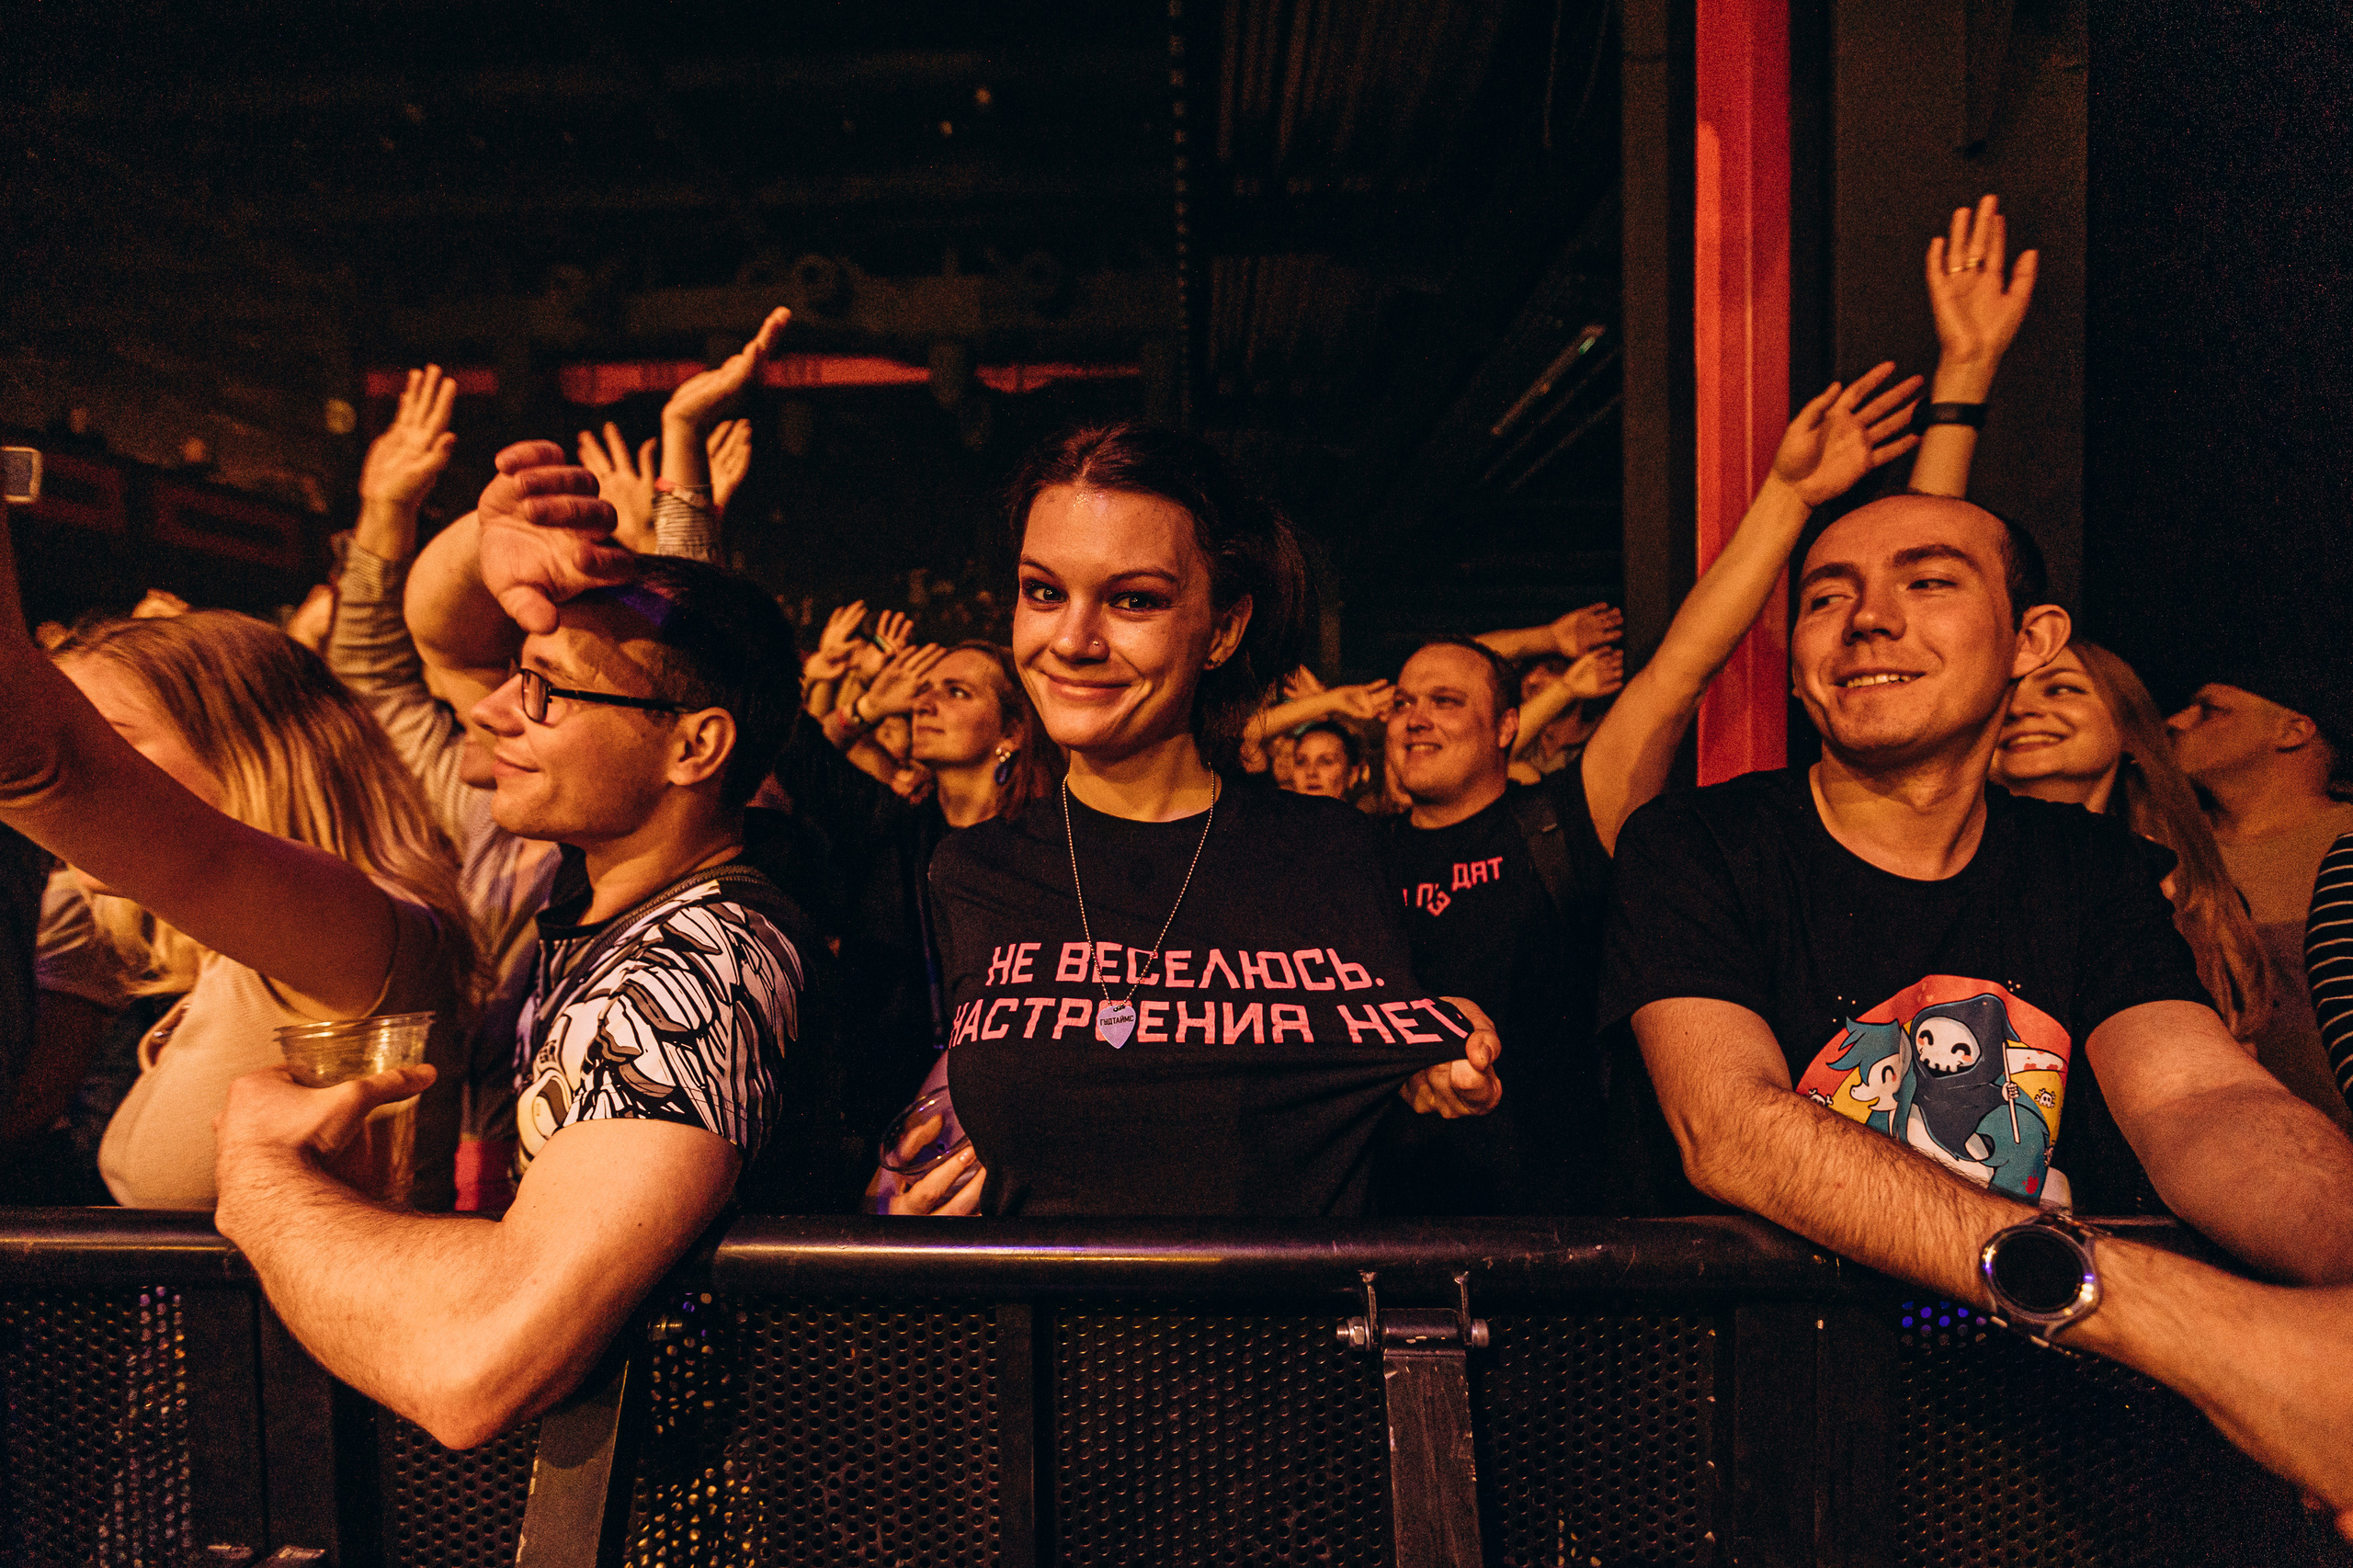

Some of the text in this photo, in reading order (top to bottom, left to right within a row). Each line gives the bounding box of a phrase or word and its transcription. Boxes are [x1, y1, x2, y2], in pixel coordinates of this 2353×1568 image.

[984, 941, 1385, 991] НЕ ВЕСЕЛЮСЬ.
[1099, 1015, 1134, 1026] ГУДТАЙМС
